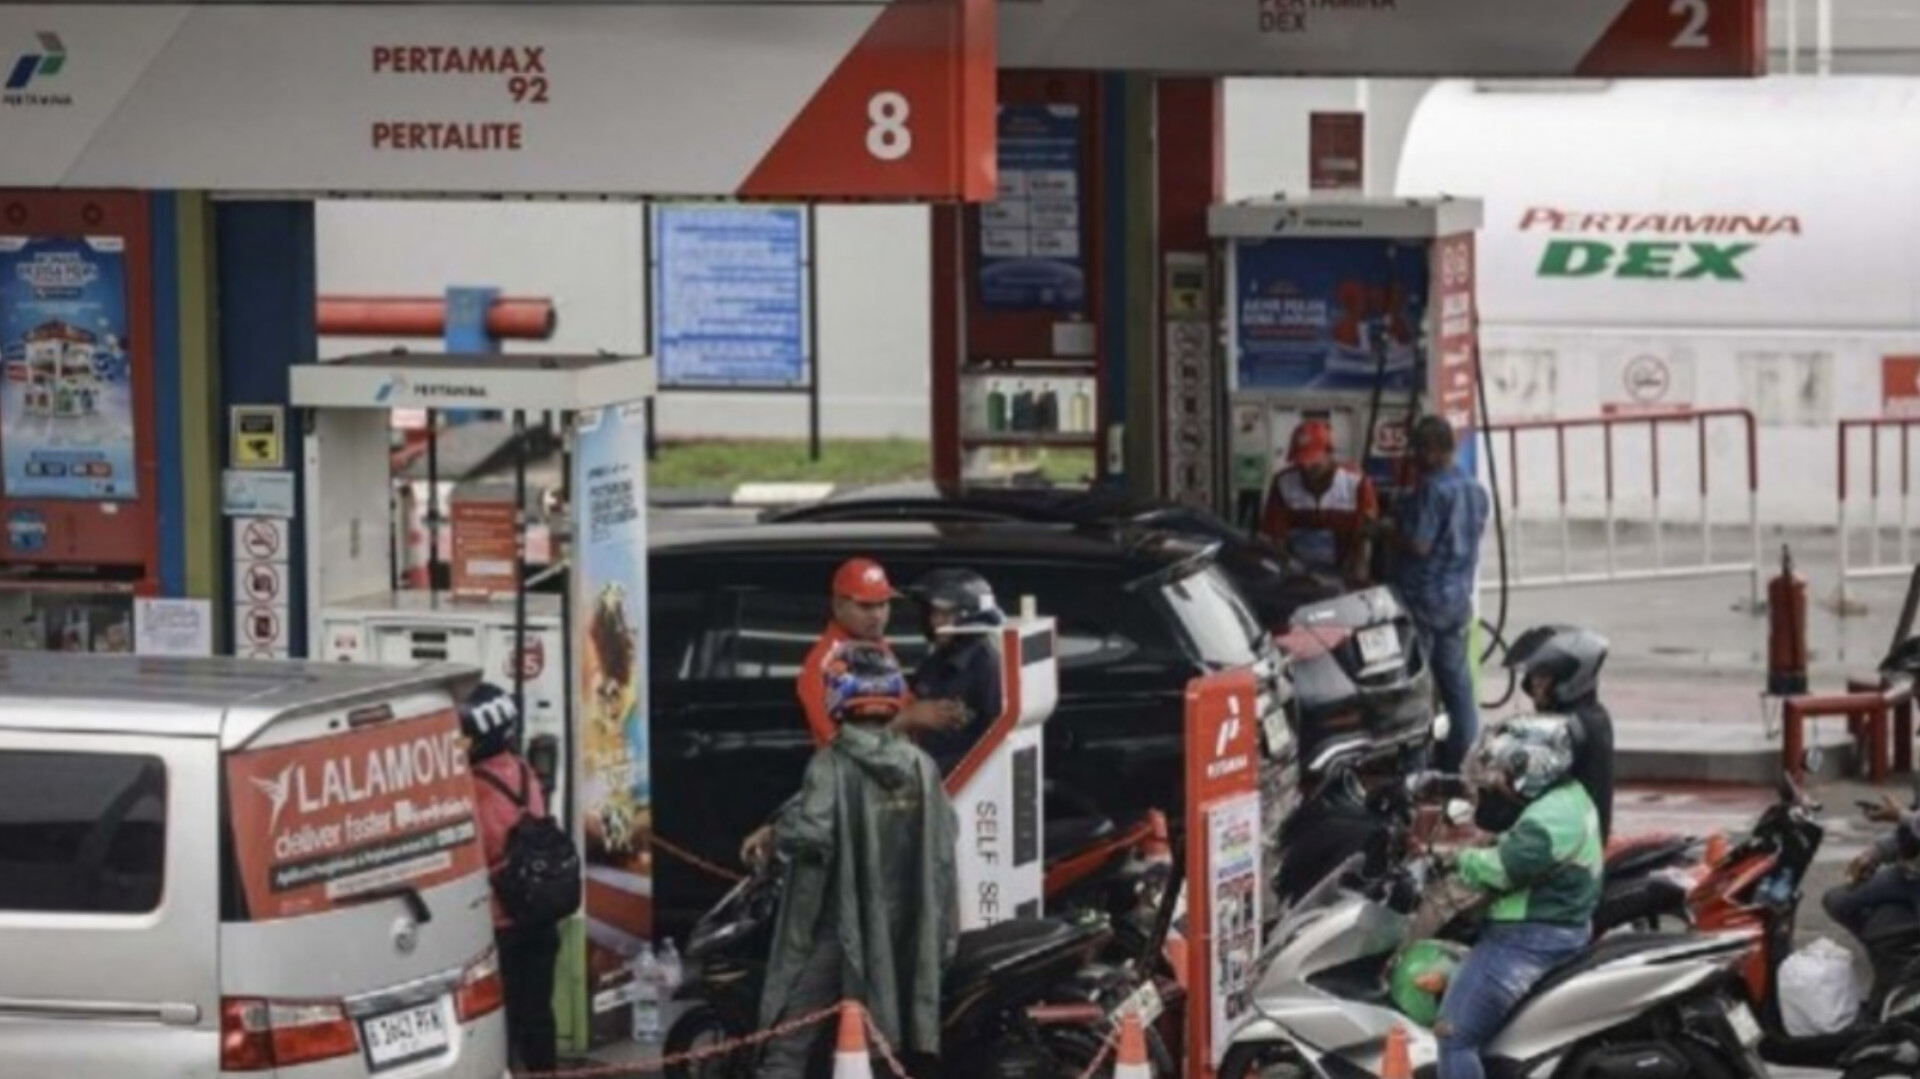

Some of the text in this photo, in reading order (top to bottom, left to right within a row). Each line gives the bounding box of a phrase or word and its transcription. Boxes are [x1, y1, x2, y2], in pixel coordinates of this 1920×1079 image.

[1259, 11, 1306, 32] DEX
[1668, 0, 1710, 47] 2
[372, 46, 545, 73] PERTAMAX
[508, 76, 549, 103] 92
[372, 122, 522, 149] PERTALITE
[865, 91, 912, 160] 8
[1518, 207, 1802, 235] PERTAMINA
[1535, 240, 1757, 280] DEX
[297, 730, 467, 814] LALAMOVE
[275, 824, 342, 859] deliver
[976, 801, 999, 866] SELF
